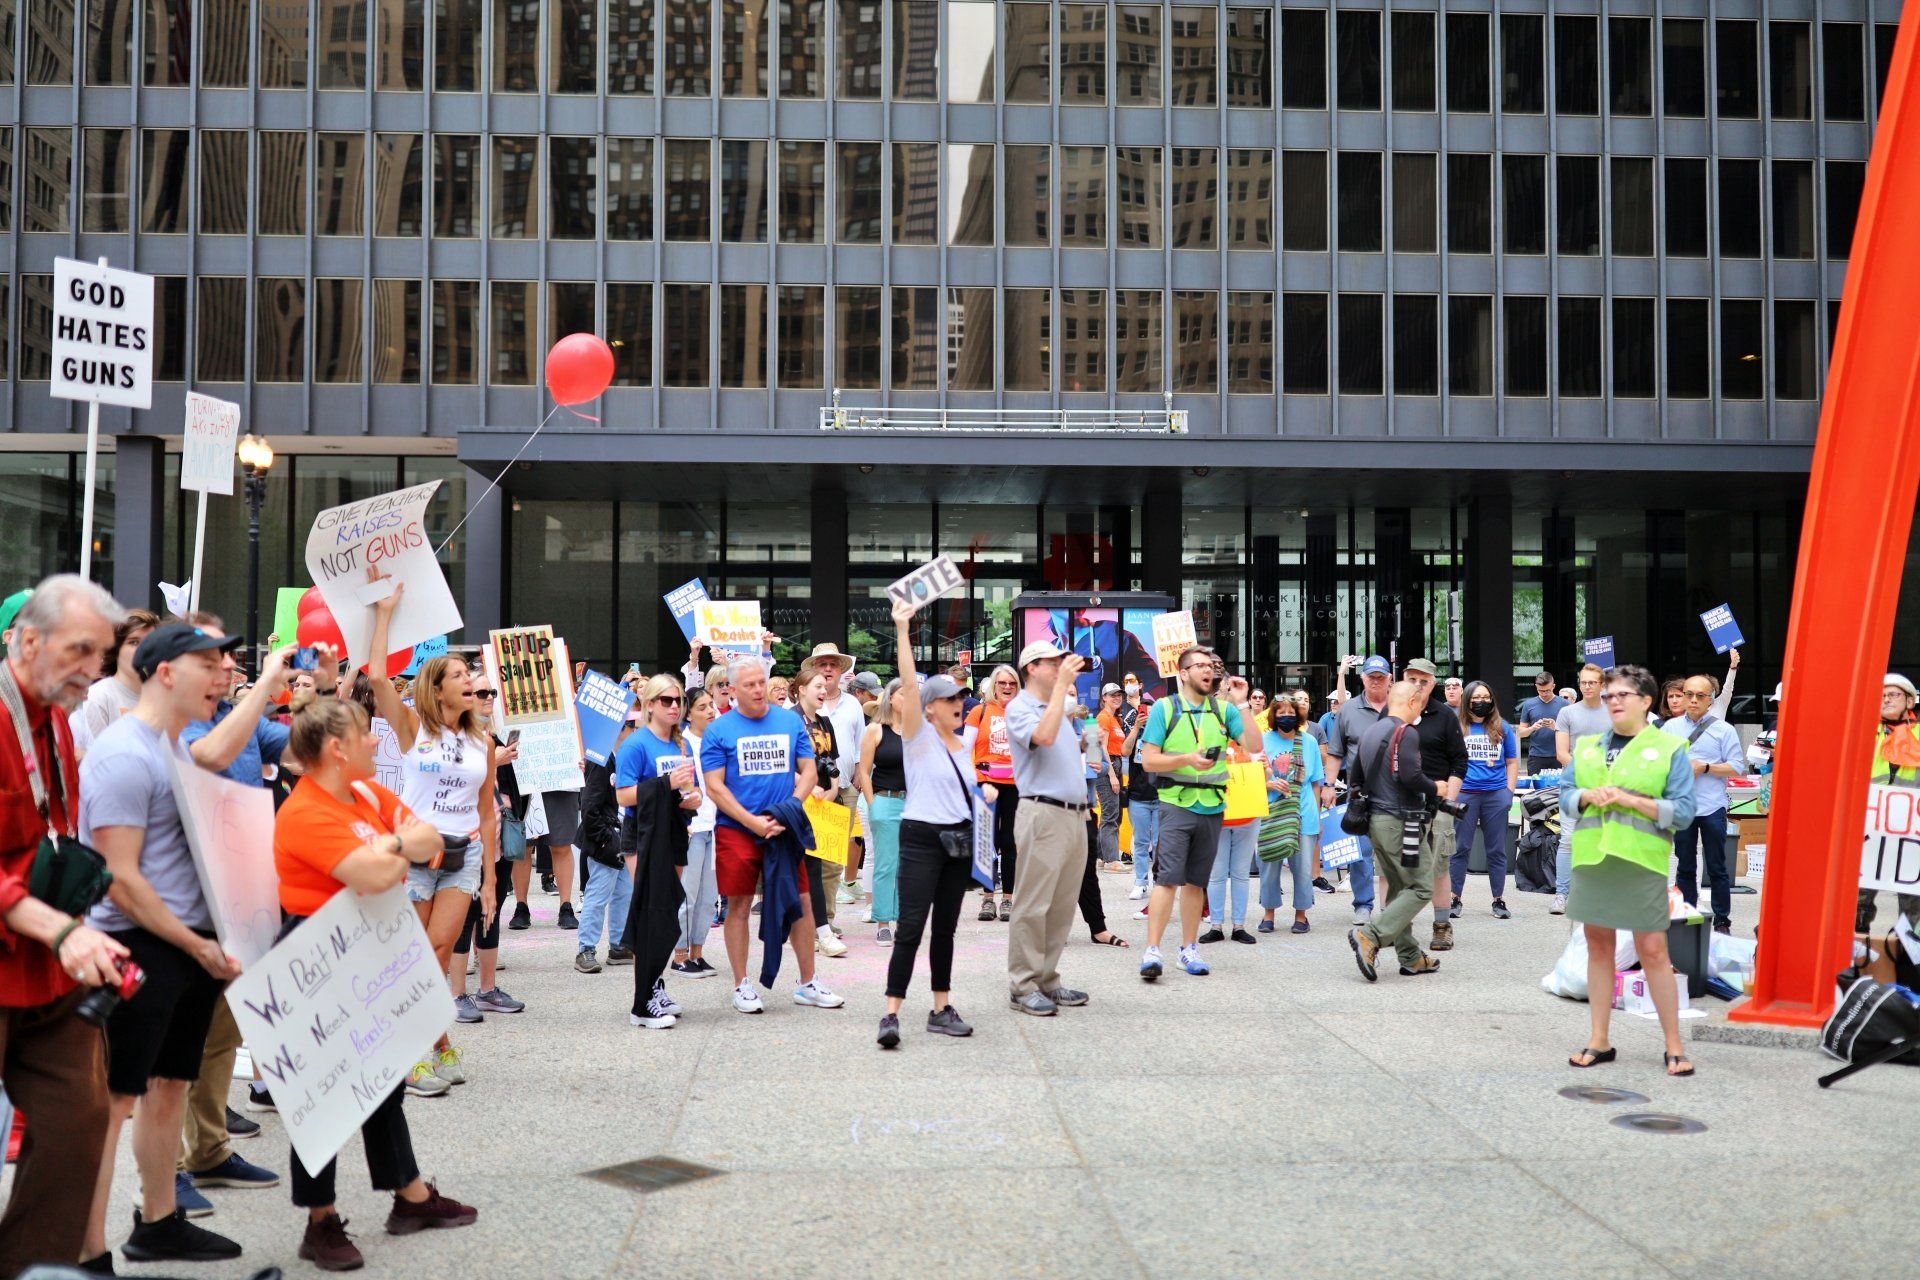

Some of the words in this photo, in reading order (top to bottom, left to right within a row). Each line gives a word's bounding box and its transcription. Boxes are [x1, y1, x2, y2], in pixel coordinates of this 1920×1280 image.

[70, 278, 124, 309] GOD
[58, 315, 146, 351] HATES
[62, 357, 134, 389] GUNS
[317, 503, 364, 529] GIVE
[365, 486, 435, 516] TEACHERS
[336, 508, 402, 545] RAISES
[320, 543, 362, 581] NOT
[366, 521, 423, 563] GUNS
[890, 558, 959, 605] VOTE
[666, 583, 696, 603] MARCH
[670, 597, 688, 611] FOR
[687, 588, 705, 602] OUR
[702, 605, 725, 626] No
[1703, 607, 1724, 620] MARCH
[1704, 617, 1718, 626] FOR
[1717, 611, 1730, 620] OUR
[1157, 624, 1192, 642] LIVE
[1585, 637, 1608, 646] MARCH
[500, 635, 522, 656] GET
[525, 634, 550, 654] UP
[1160, 641, 1193, 653] WITHOUT
[534, 658, 554, 681] UP
[582, 683, 605, 703] FOR
[604, 694, 629, 714] OUR
[587, 674, 627, 701] MARCH
[579, 693, 609, 716] LIVES
[742, 740, 778, 750] MARCH
[743, 751, 763, 760] FOR
[765, 750, 785, 759] OUR
[419, 761, 441, 773] left
[744, 762, 772, 771] LIVES
[438, 775, 467, 788] side
[435, 789, 451, 799] of
[432, 801, 473, 814] history
[1329, 851, 1360, 867] MARCH
[244, 973, 294, 1028] We
[288, 943, 332, 994] Don't
[329, 908, 373, 960] Need
[261, 1043, 307, 1086] We
[310, 1004, 351, 1047] Need
[292, 1090, 316, 1128] and
[316, 1057, 351, 1096] some
[349, 1013, 392, 1057] Pencils
[417, 977, 436, 994] be
[350, 1064, 397, 1112] Nice
